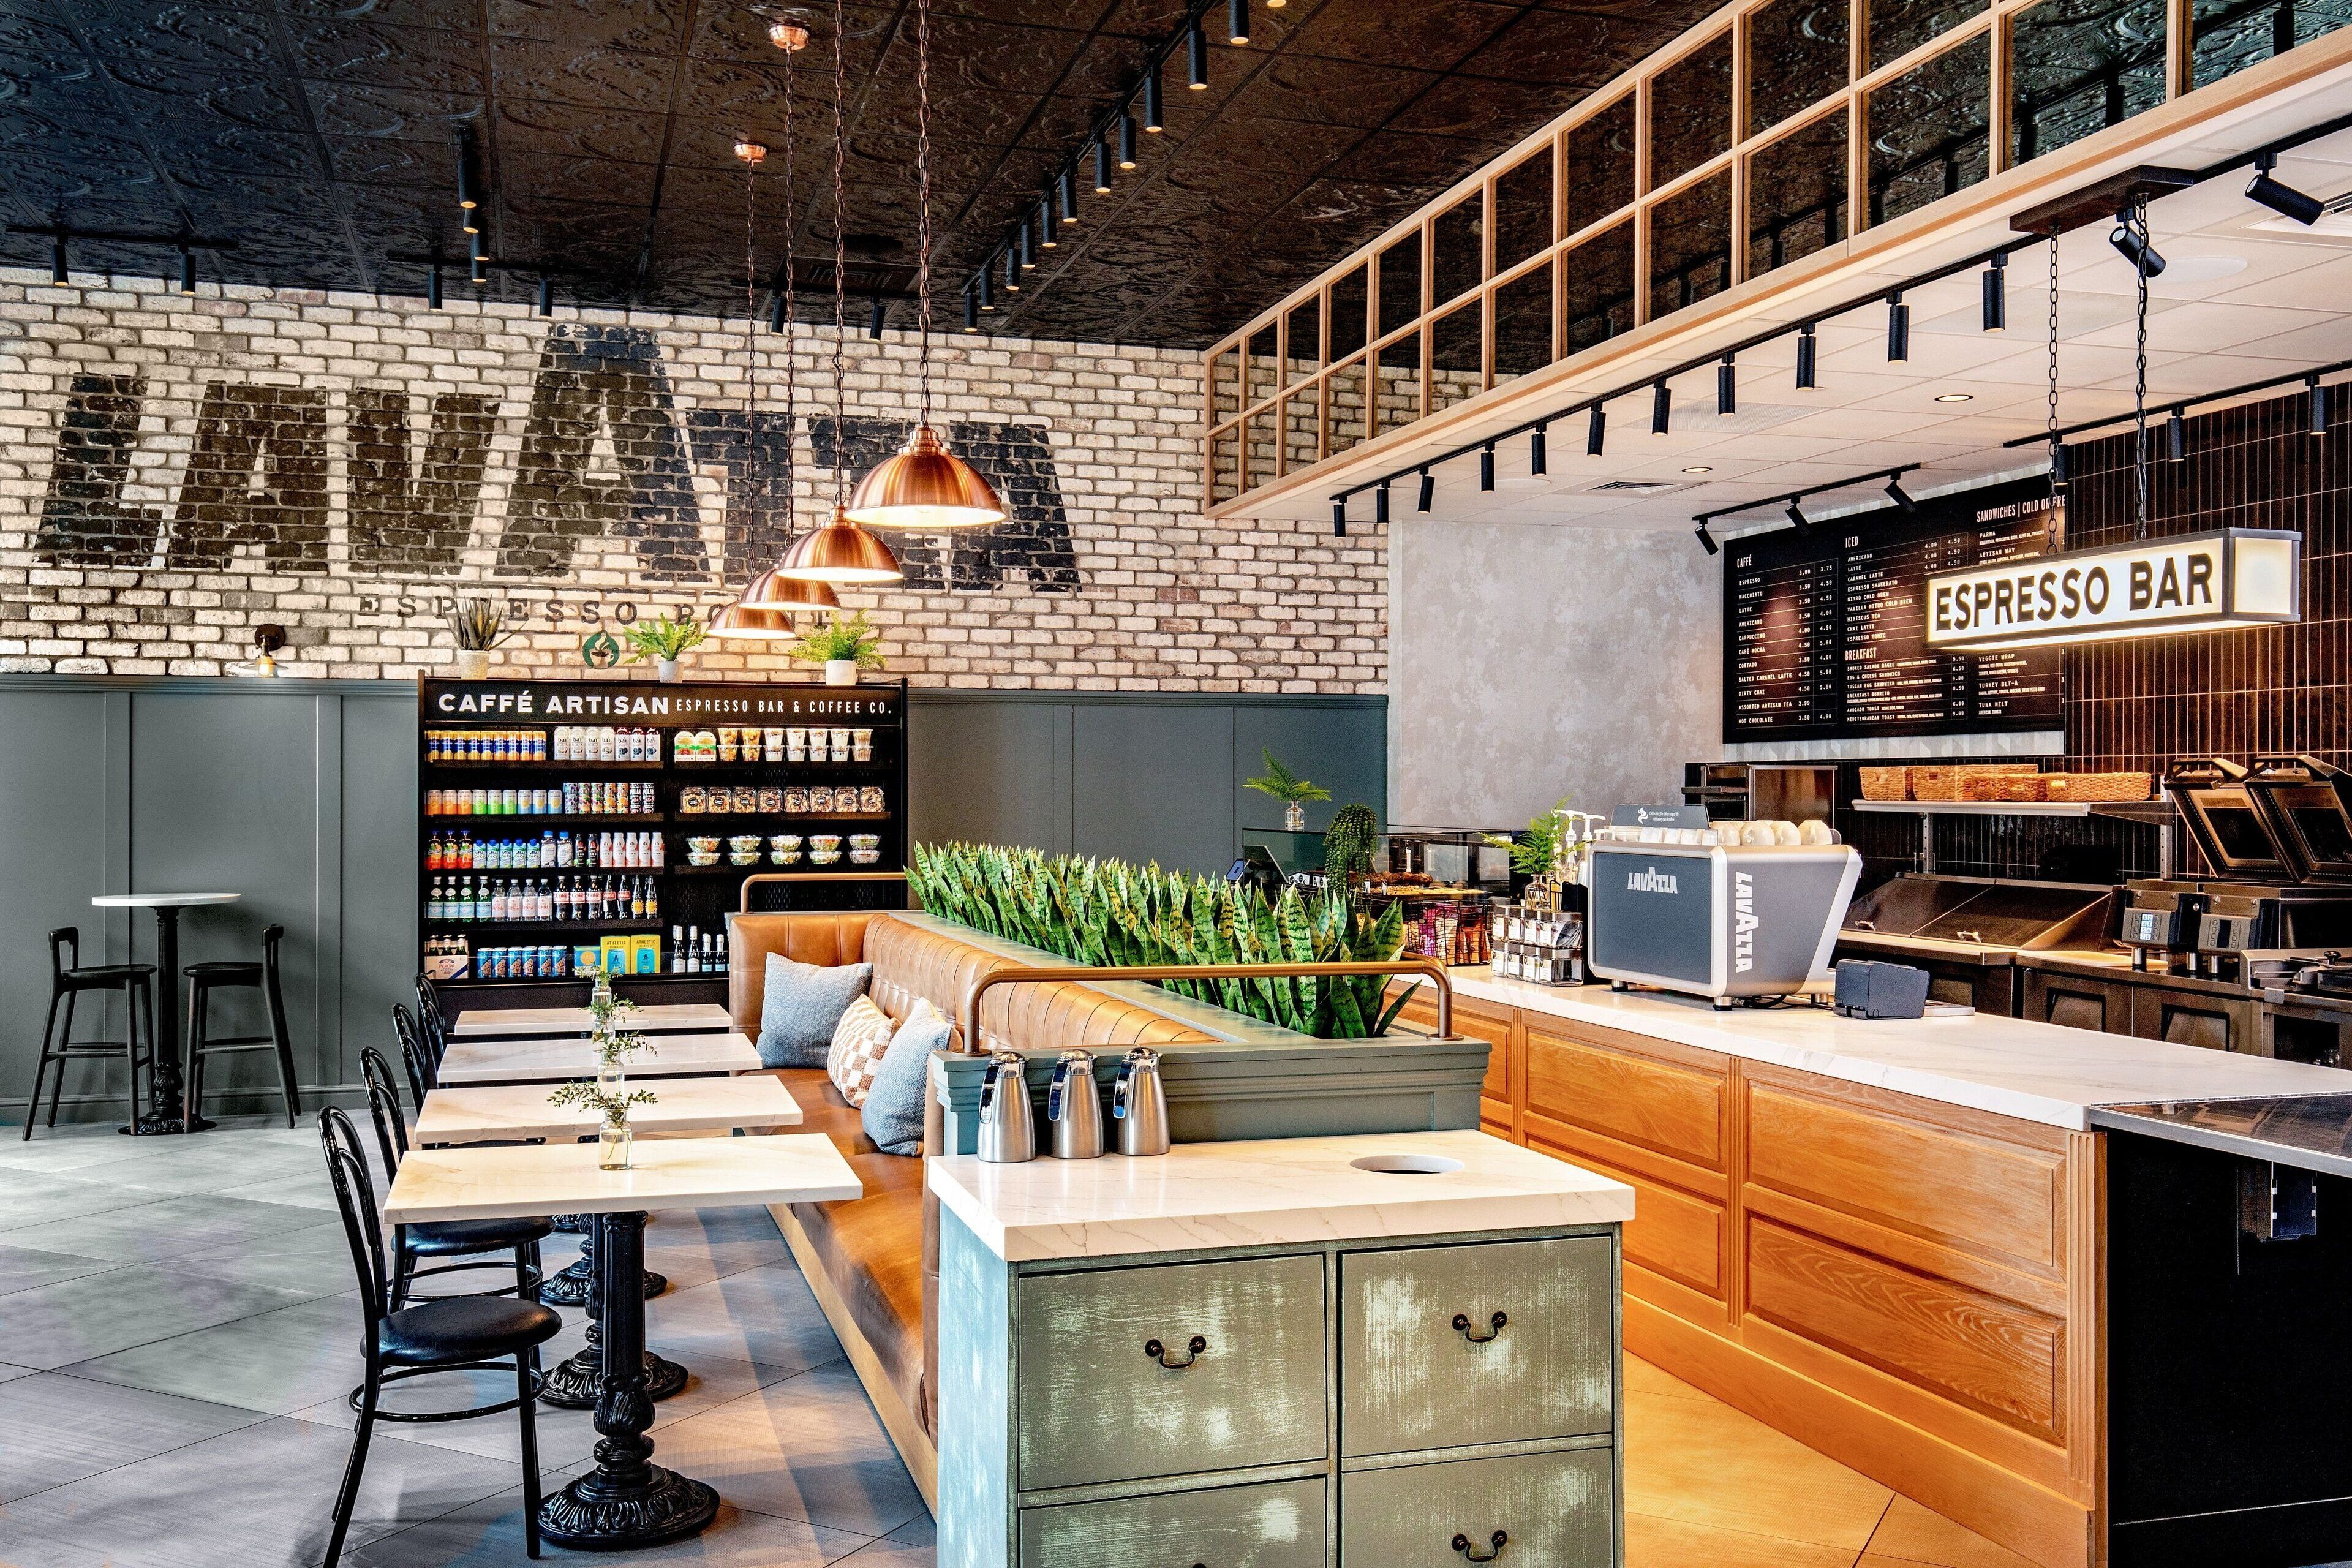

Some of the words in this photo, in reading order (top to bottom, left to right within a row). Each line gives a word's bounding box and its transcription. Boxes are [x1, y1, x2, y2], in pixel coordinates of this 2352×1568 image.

[1977, 504, 2016, 522] SANDWICHES
[2022, 500, 2038, 514] COLD
[1845, 536, 1858, 548] ICED
[1848, 554, 1872, 562] AMERICANO
[1980, 549, 2002, 558] ARTISAN
[1737, 554, 1752, 568] CAFFÉ
[1872, 580, 1898, 589] SHAKERATO
[1936, 565, 2110, 632] ESPRESSO
[2129, 552, 2212, 612] BAR
[1845, 647, 1877, 661] BREAKFAST
[438, 690, 533, 713] CAFFÉ
[545, 695, 669, 715] ARTISAN
[676, 699, 748, 712] ESPRESSO
[758, 700, 784, 713] BAR
[793, 701, 800, 713] &
[809, 701, 861, 714] COFFEE
[869, 701, 892, 714] CO.
[1627, 866, 1678, 895] LAVAZZA
[1735, 871, 1759, 974] LAVAZZA
